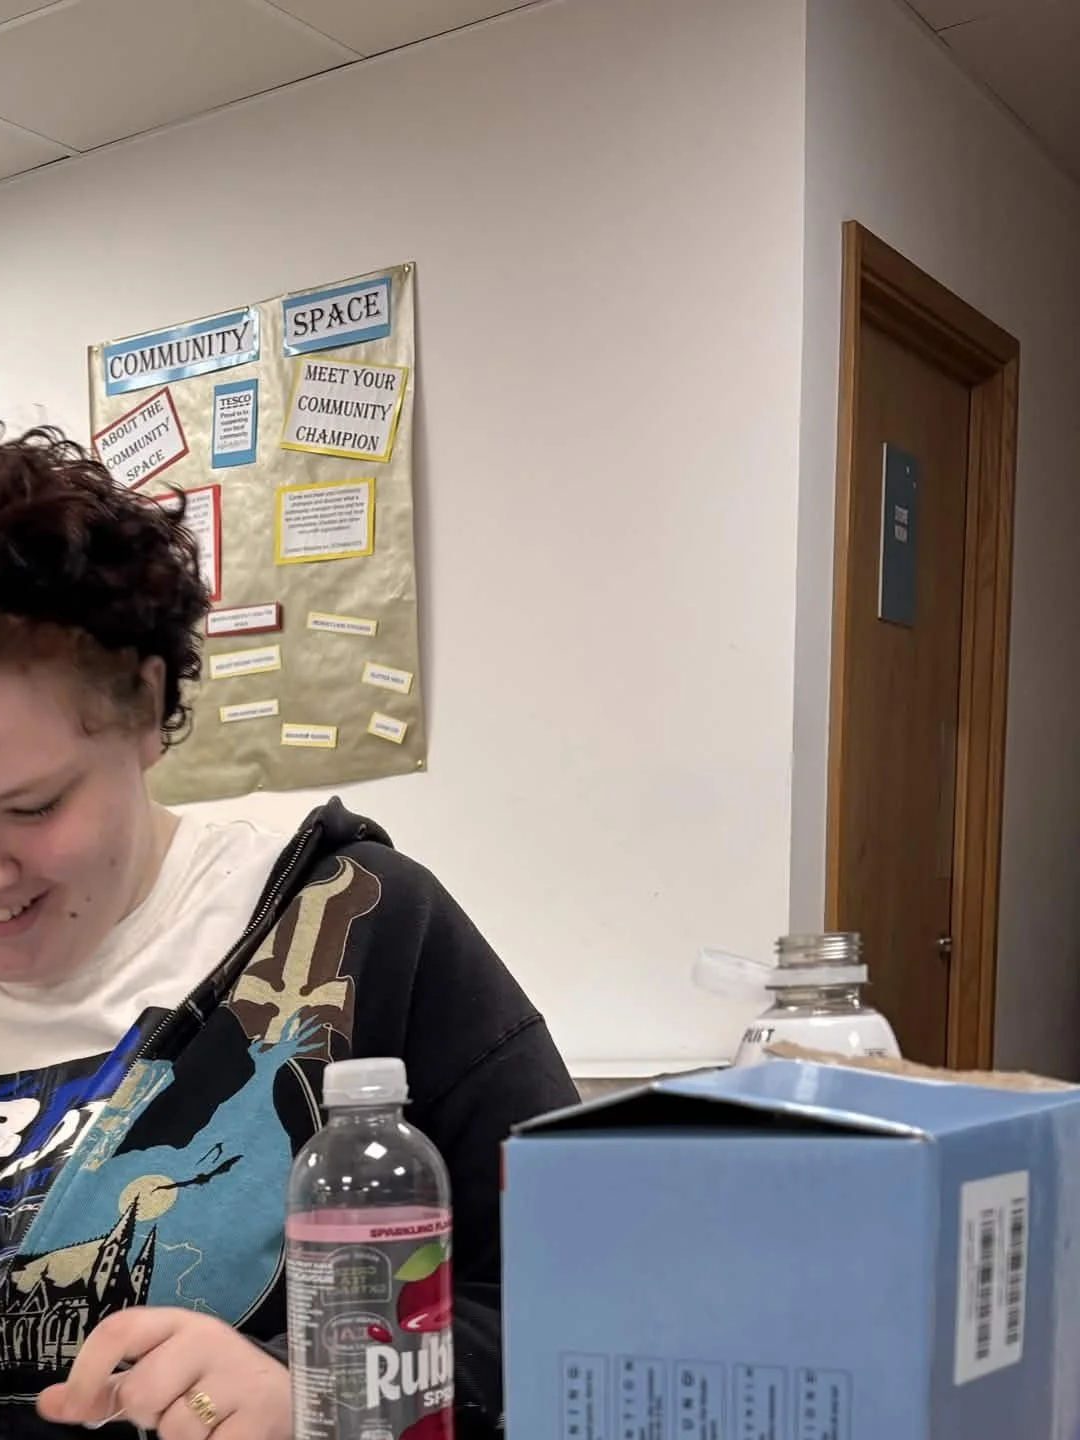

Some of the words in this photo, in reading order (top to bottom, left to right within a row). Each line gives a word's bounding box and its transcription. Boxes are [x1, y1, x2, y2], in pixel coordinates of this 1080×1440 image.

[109, 321, 250, 380] COMMUNITY
[293, 292, 381, 337] SPACE
[304, 364, 350, 385] MEET
[354, 368, 396, 391] YOUR
[220, 394, 251, 407] TESCO
[297, 395, 393, 421] COMMUNITY
[101, 416, 139, 450] ABOUT
[139, 399, 165, 422] THE
[295, 425, 379, 451] CHAMPION
[106, 415, 170, 470] COMMUNITY
[126, 448, 166, 482] SPACE
